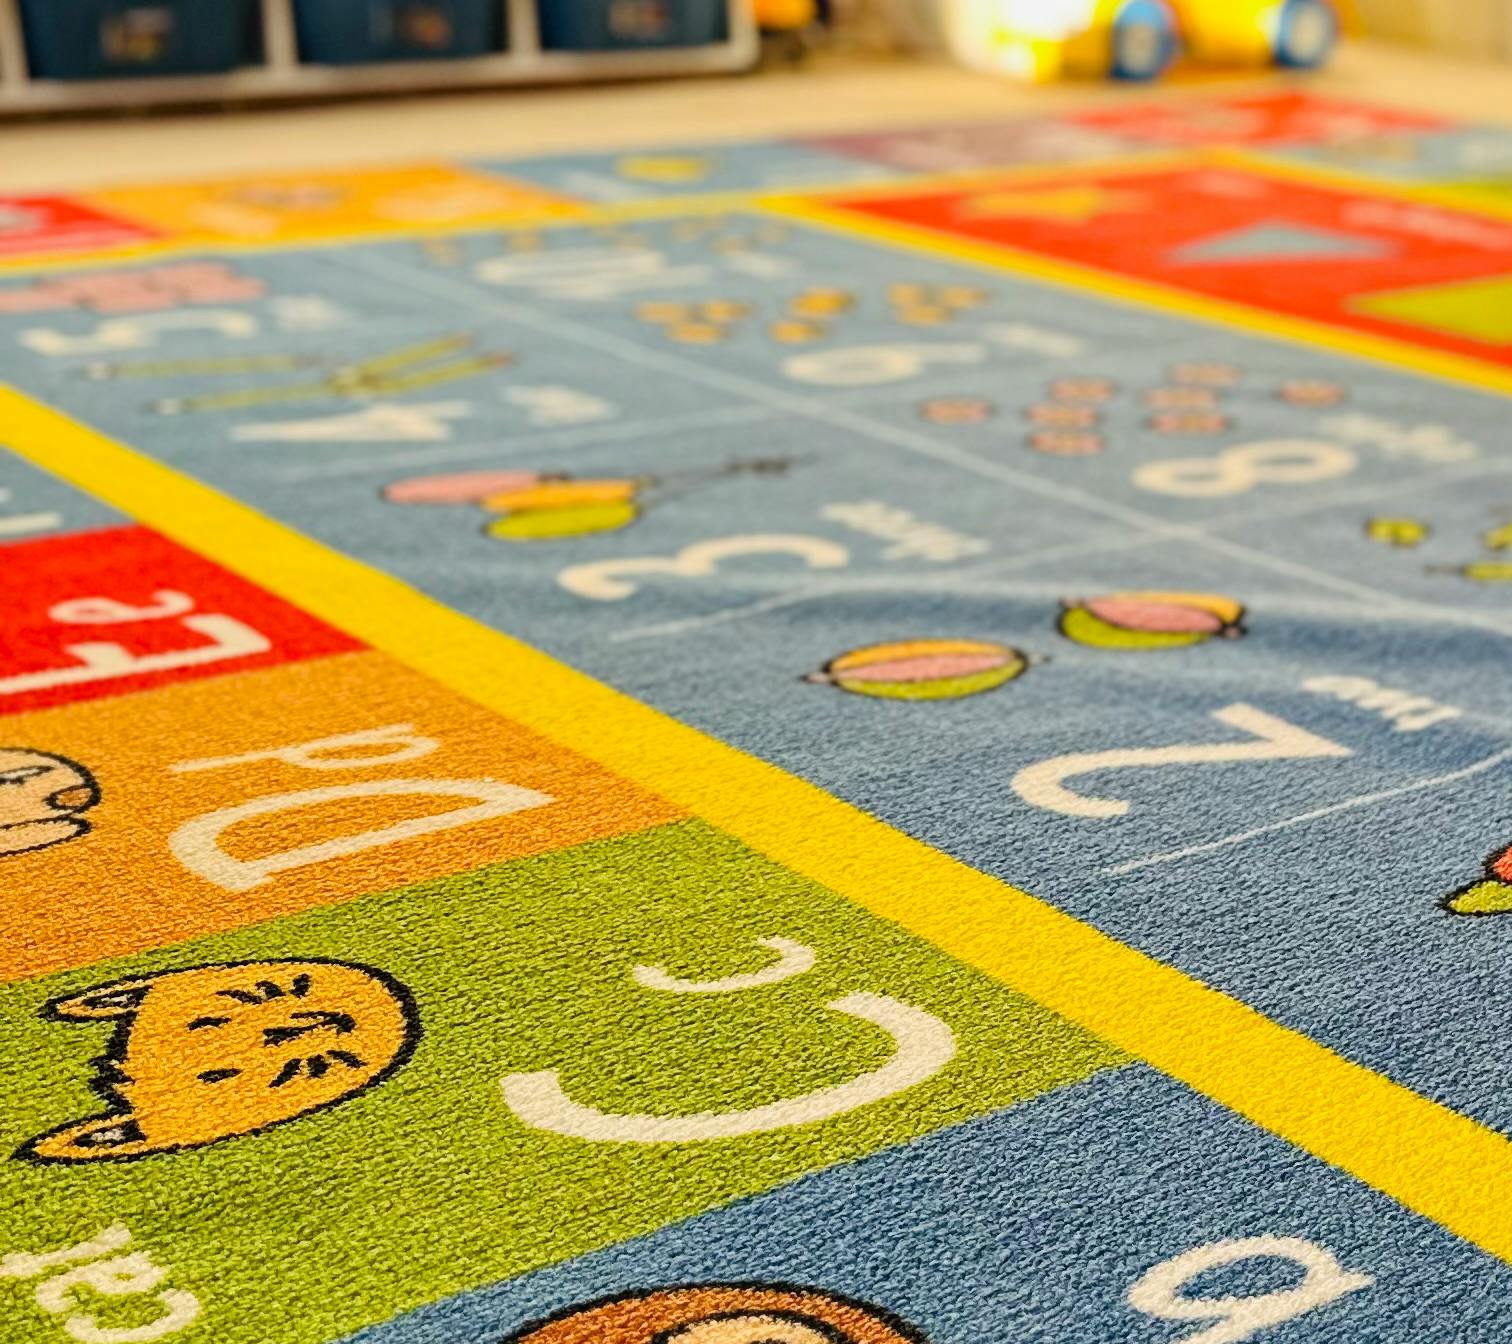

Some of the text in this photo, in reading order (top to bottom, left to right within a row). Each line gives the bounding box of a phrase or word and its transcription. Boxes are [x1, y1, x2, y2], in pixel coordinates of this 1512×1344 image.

[1132, 439, 1357, 498] 8
[557, 533, 849, 602] 3
[1010, 702, 1354, 819] 2
[1301, 673, 1463, 731] two
[168, 775, 555, 892] D
[499, 936, 960, 1144] C c
[0, 1218, 201, 1344] cat
